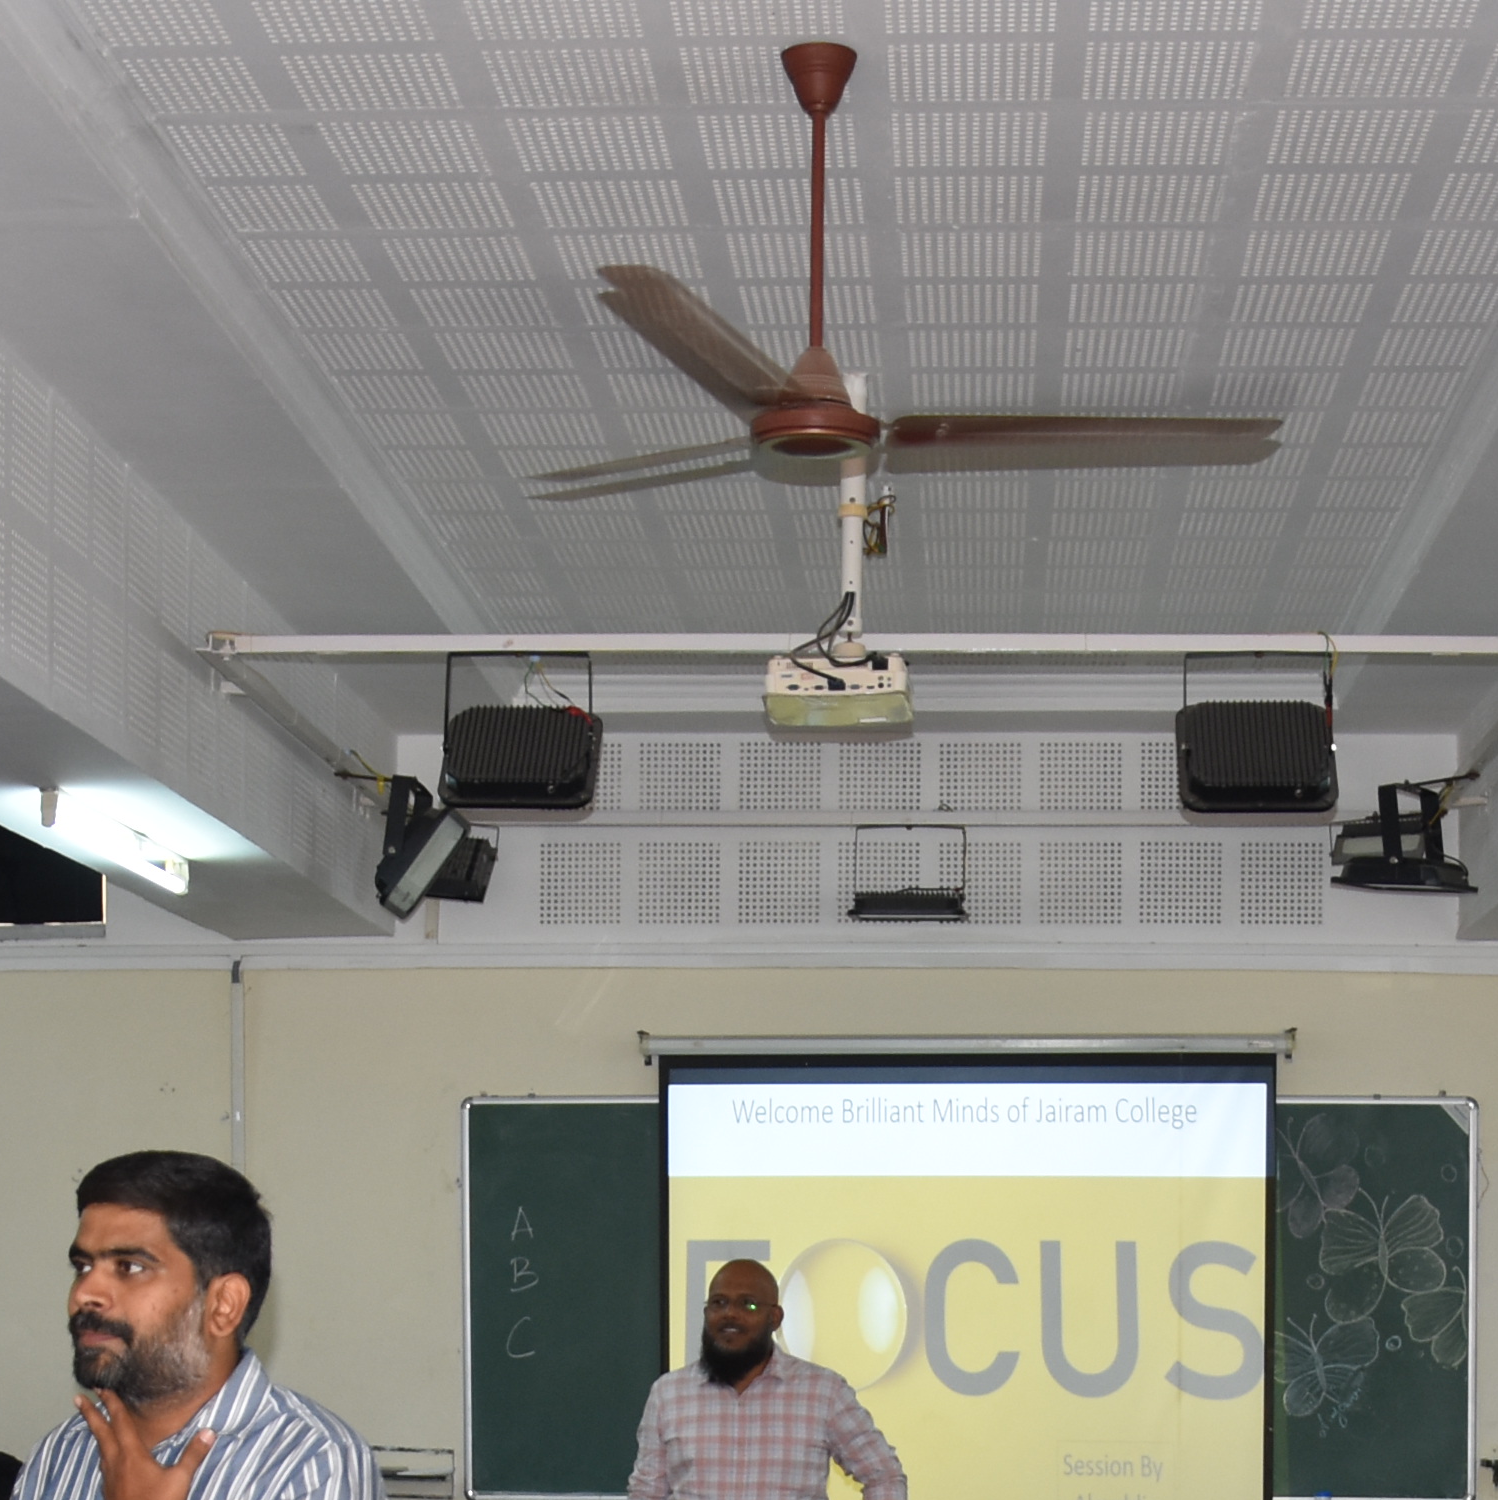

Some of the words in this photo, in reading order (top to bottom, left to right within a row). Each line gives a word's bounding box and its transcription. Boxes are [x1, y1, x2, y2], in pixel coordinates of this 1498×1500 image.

[732, 1098, 834, 1124] Welcome
[842, 1097, 924, 1124] Brilliant
[932, 1098, 1000, 1124] Minds
[1007, 1097, 1030, 1124] of
[1036, 1098, 1107, 1124] Jairam
[1115, 1097, 1198, 1129] College
[511, 1206, 534, 1241] A
[510, 1257, 539, 1292] B
[506, 1316, 536, 1358] C
[1063, 1453, 1134, 1478] Session
[1141, 1455, 1164, 1483] By
